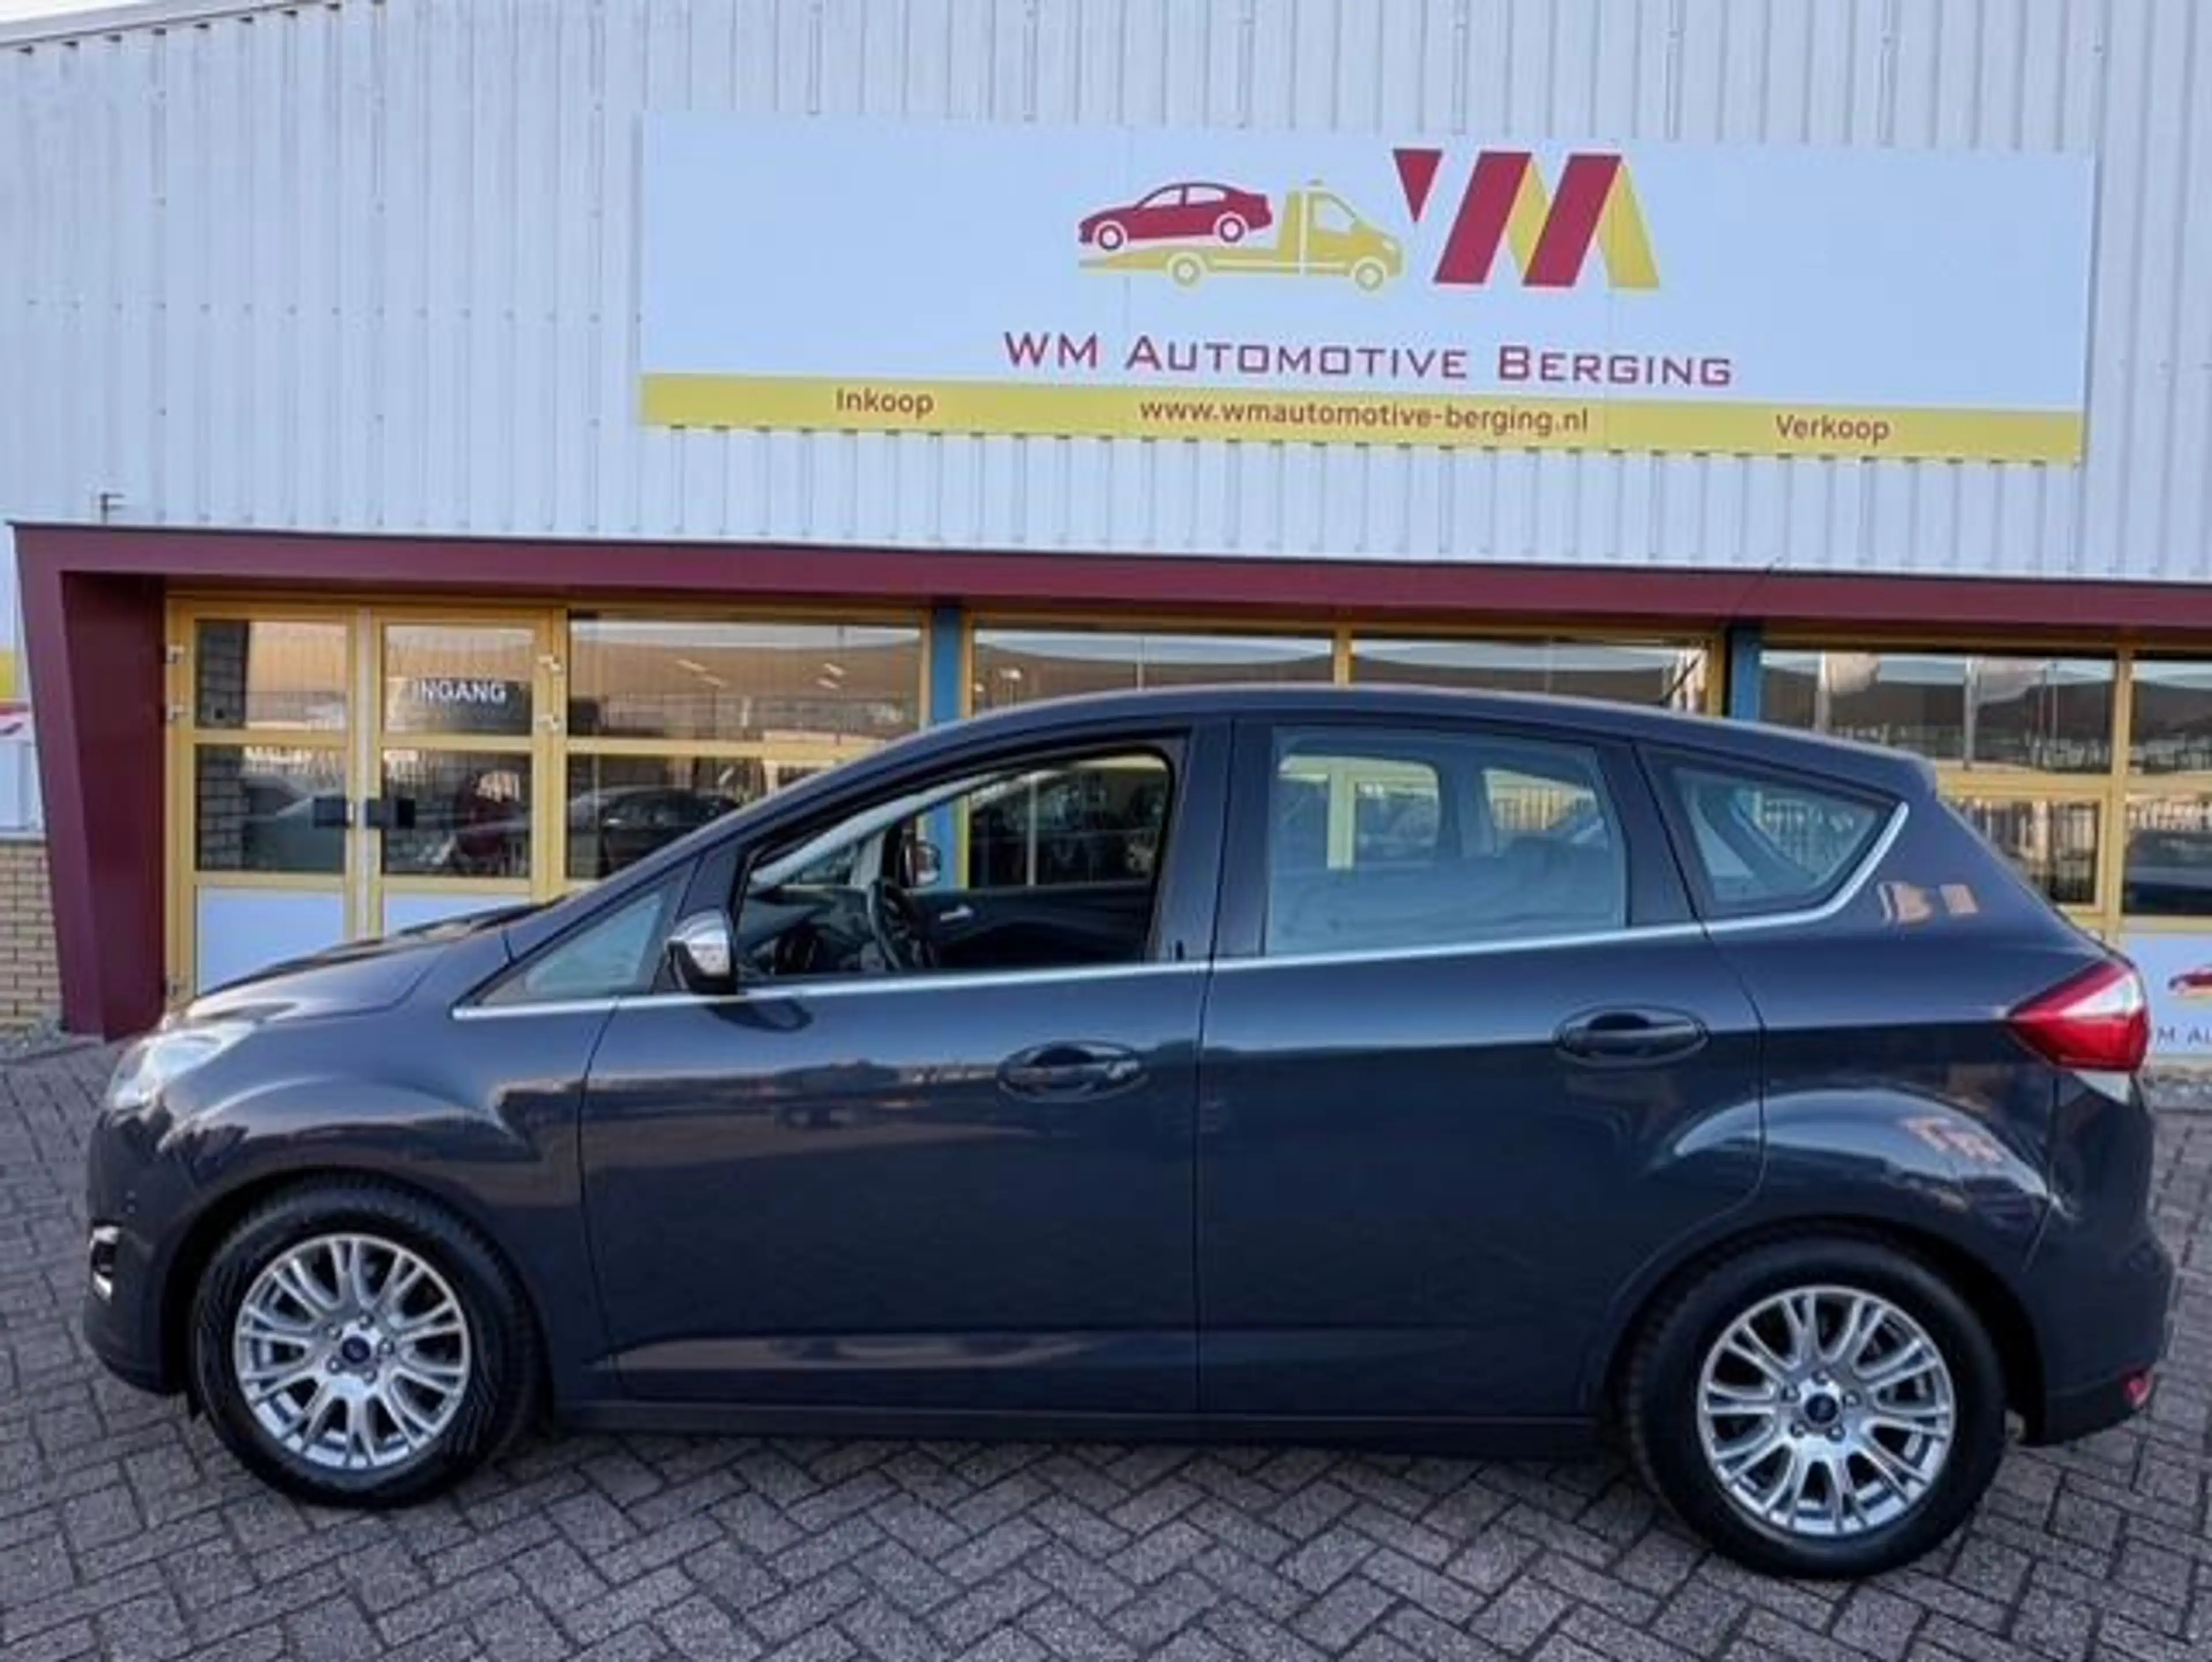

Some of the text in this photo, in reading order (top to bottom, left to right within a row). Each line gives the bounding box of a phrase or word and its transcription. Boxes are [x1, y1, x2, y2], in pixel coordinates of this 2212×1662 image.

[1004, 331, 1731, 386] WM AUTOMOTIVE BERGING
[836, 387, 934, 420] Inkoop
[1140, 401, 1588, 437] www.wmautomotive-berging.nl
[1776, 413, 1890, 448] Verkoop
